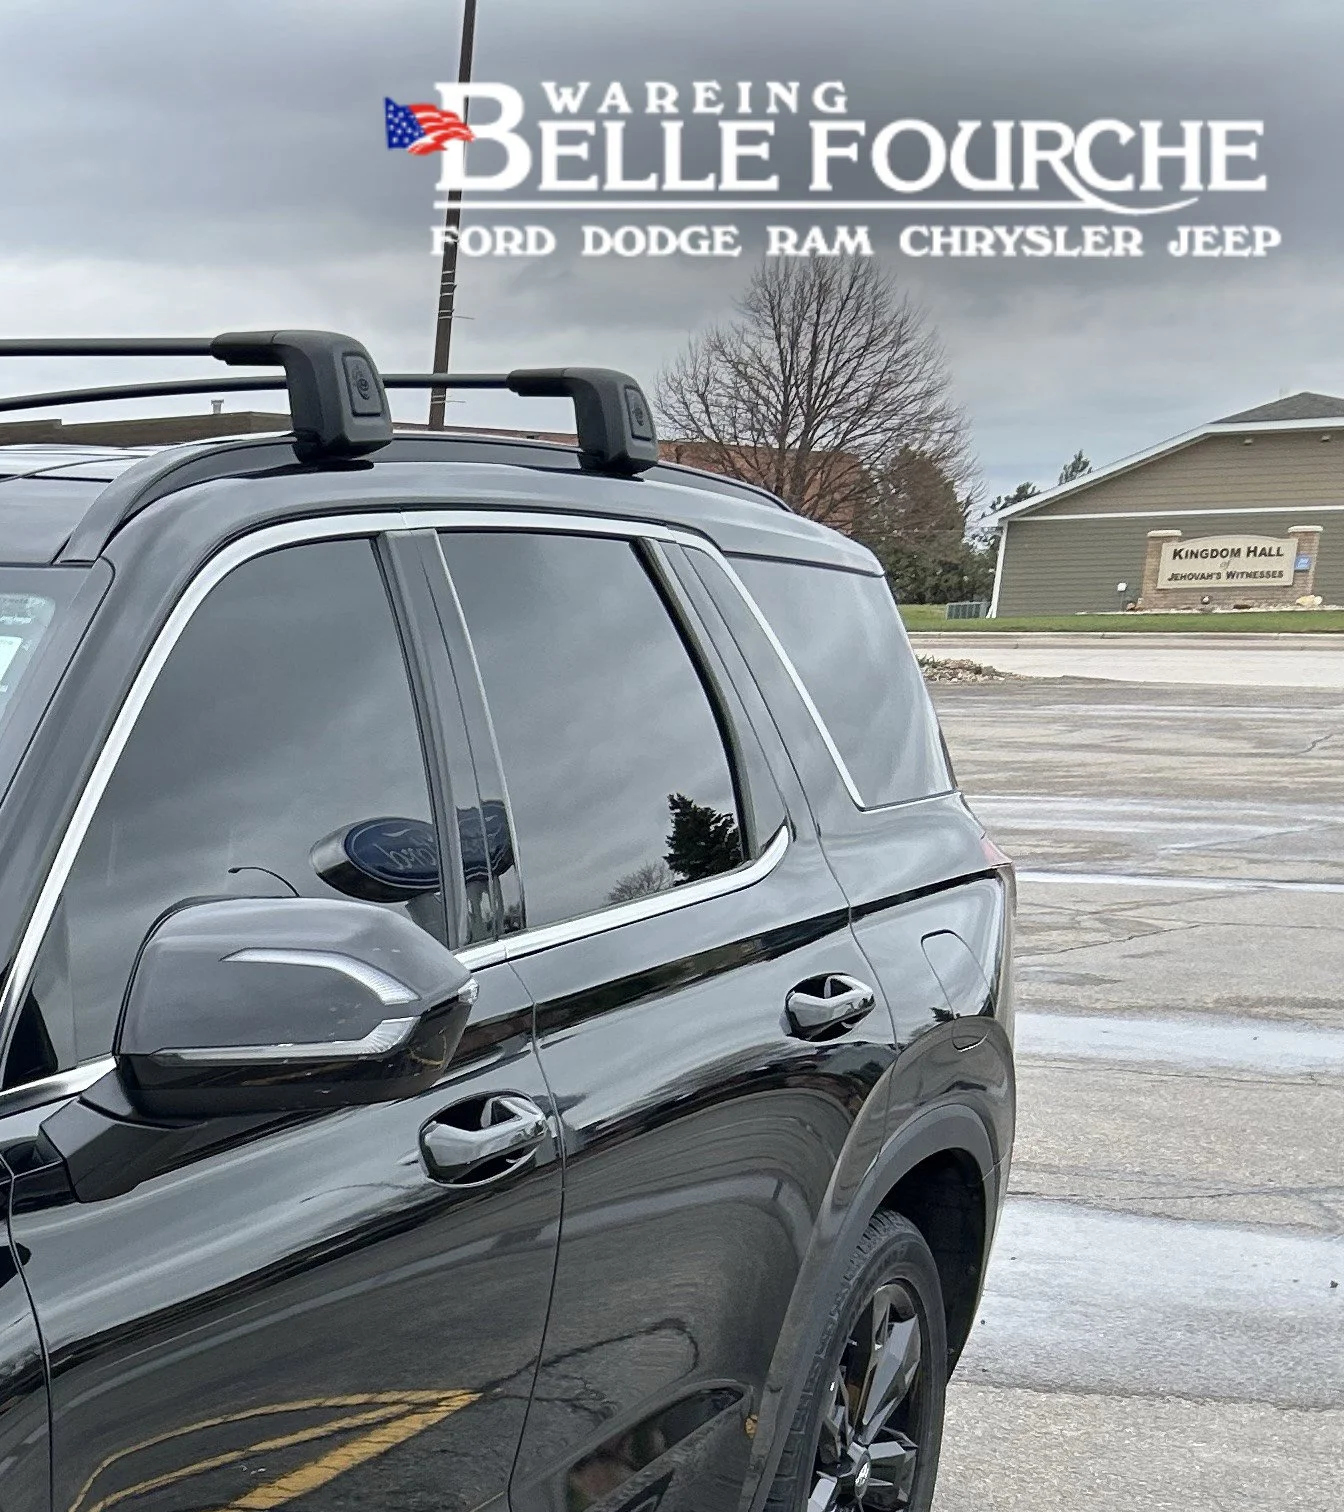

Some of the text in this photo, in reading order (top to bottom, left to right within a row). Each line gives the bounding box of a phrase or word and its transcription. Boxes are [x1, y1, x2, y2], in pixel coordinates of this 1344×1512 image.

[1172, 545, 1285, 560] KINGDOM HALL
[1226, 570, 1285, 580] WITNESSES
